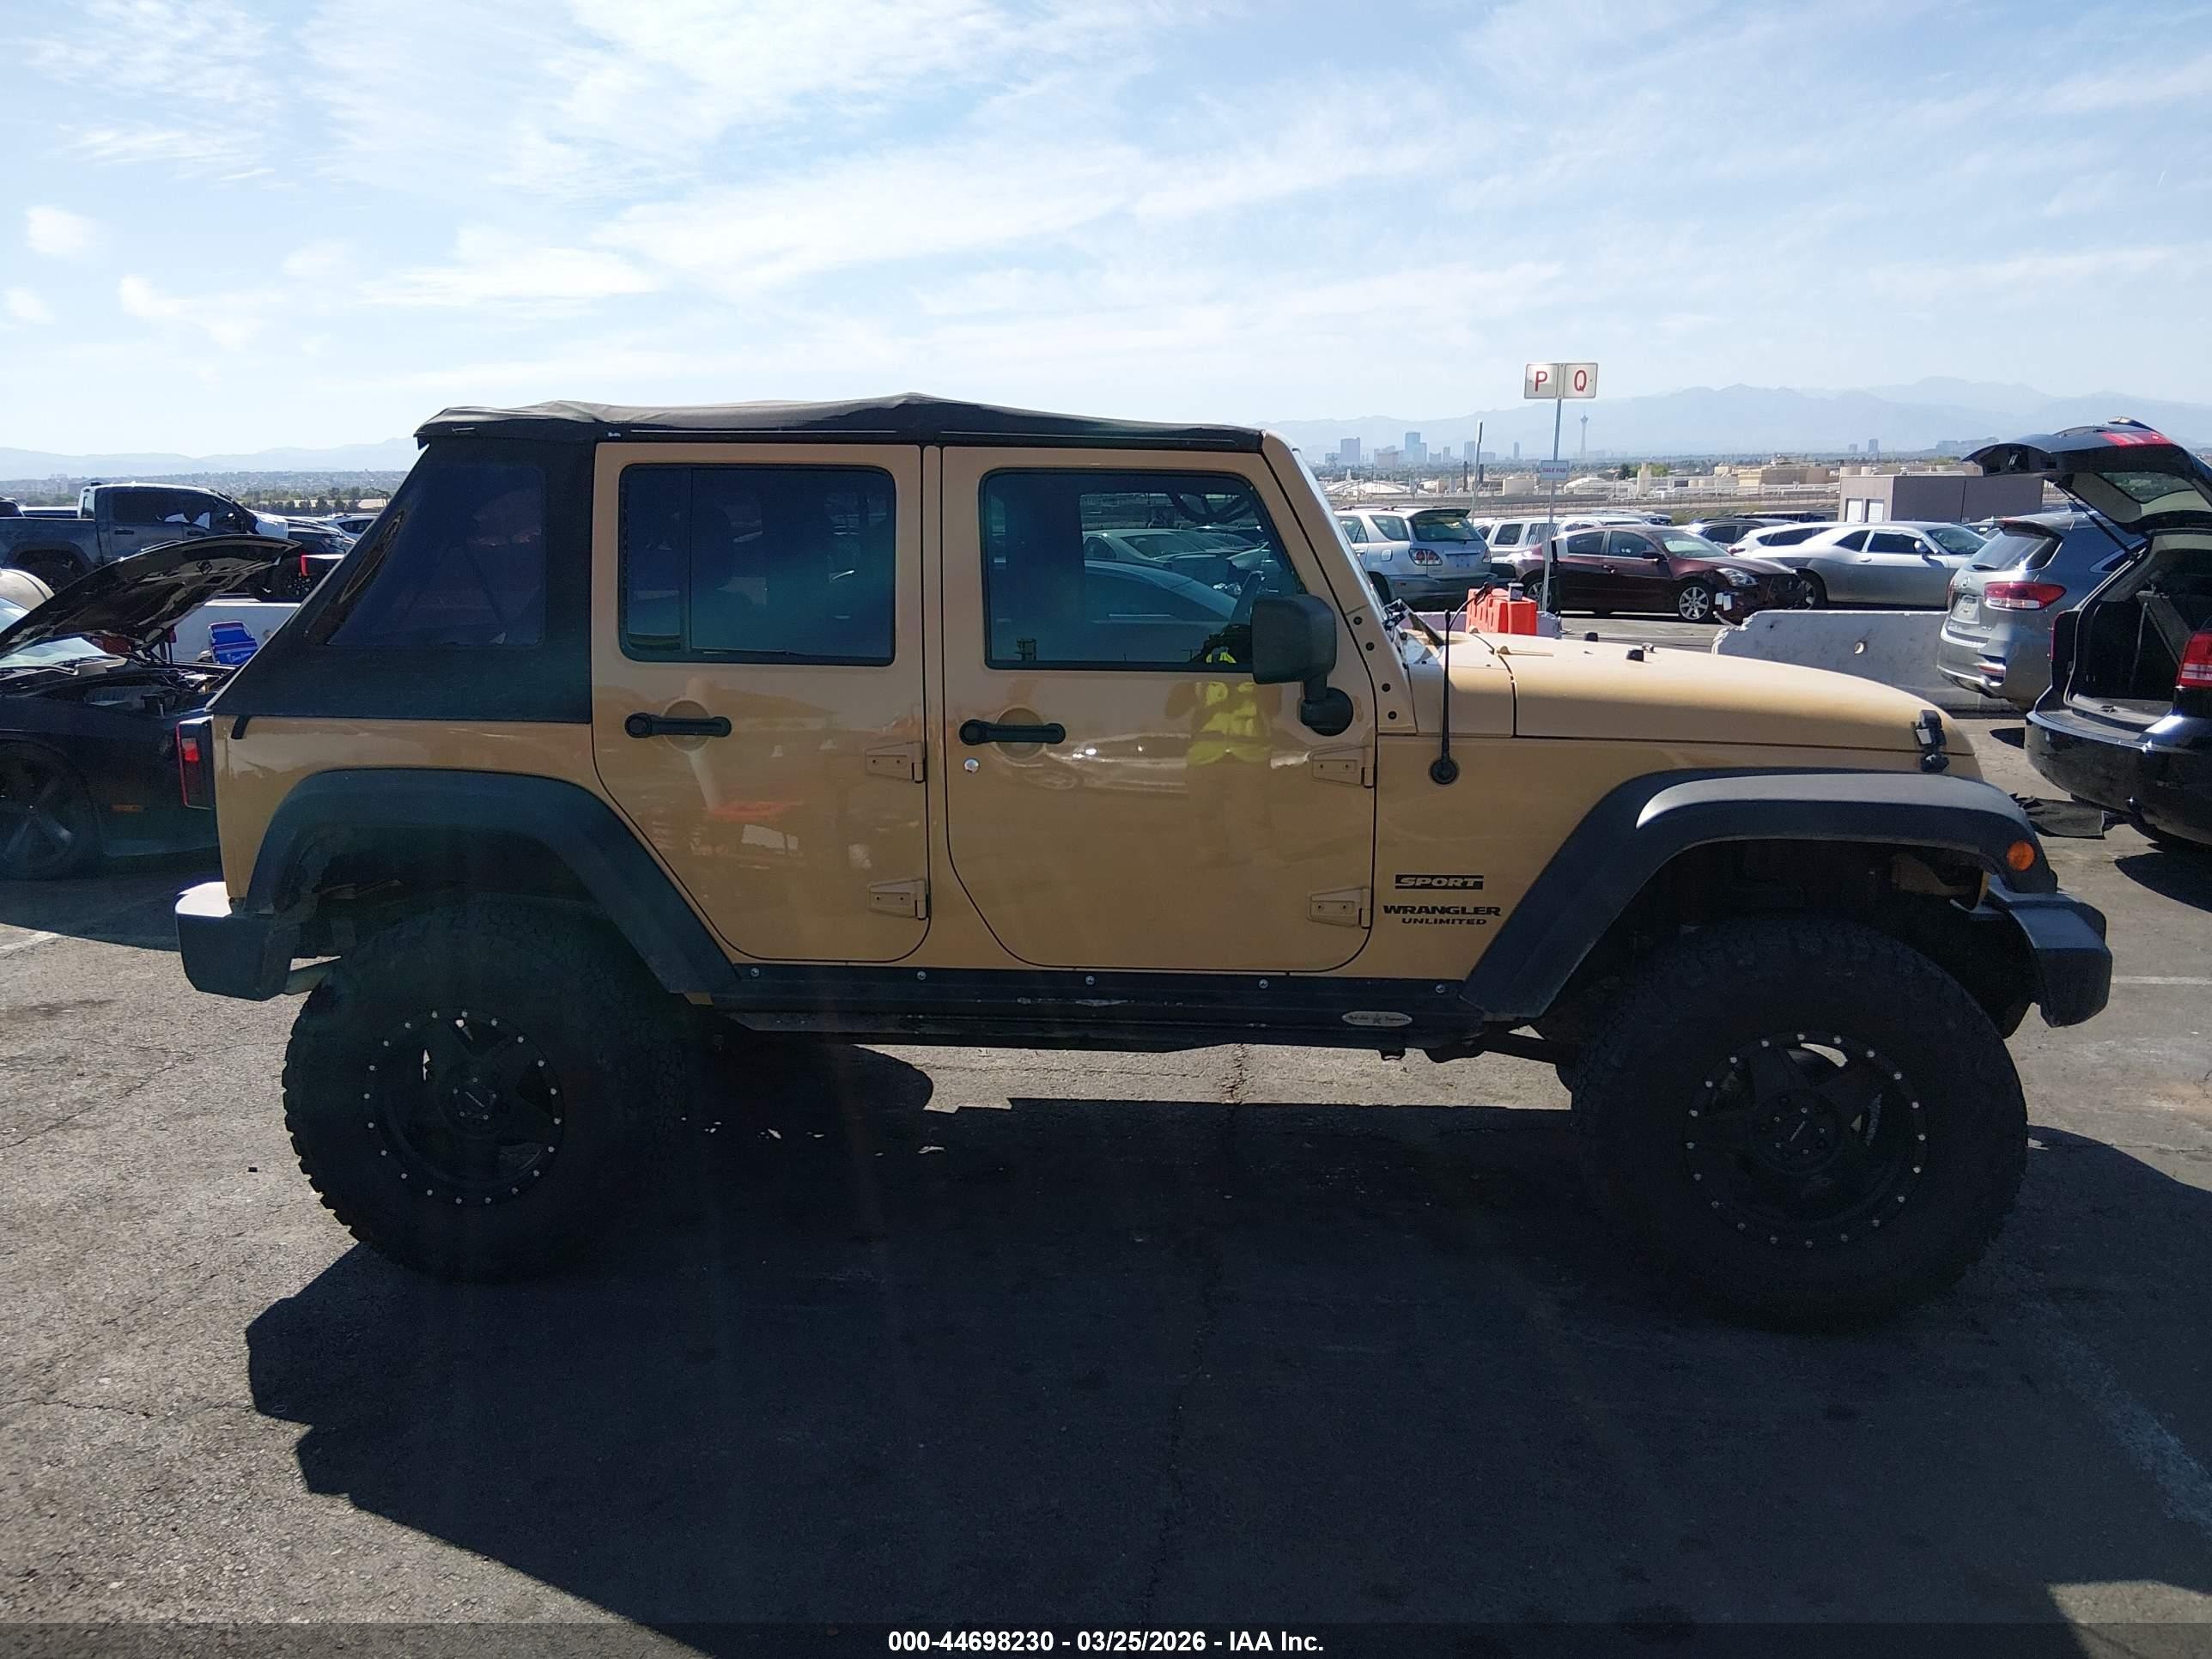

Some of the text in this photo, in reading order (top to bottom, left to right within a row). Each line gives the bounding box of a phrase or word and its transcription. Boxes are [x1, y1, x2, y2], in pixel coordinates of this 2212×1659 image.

[1534, 369, 1587, 392] P Q
[1395, 875, 1484, 889] SPORT
[1382, 905, 1502, 916] WRANGLER
